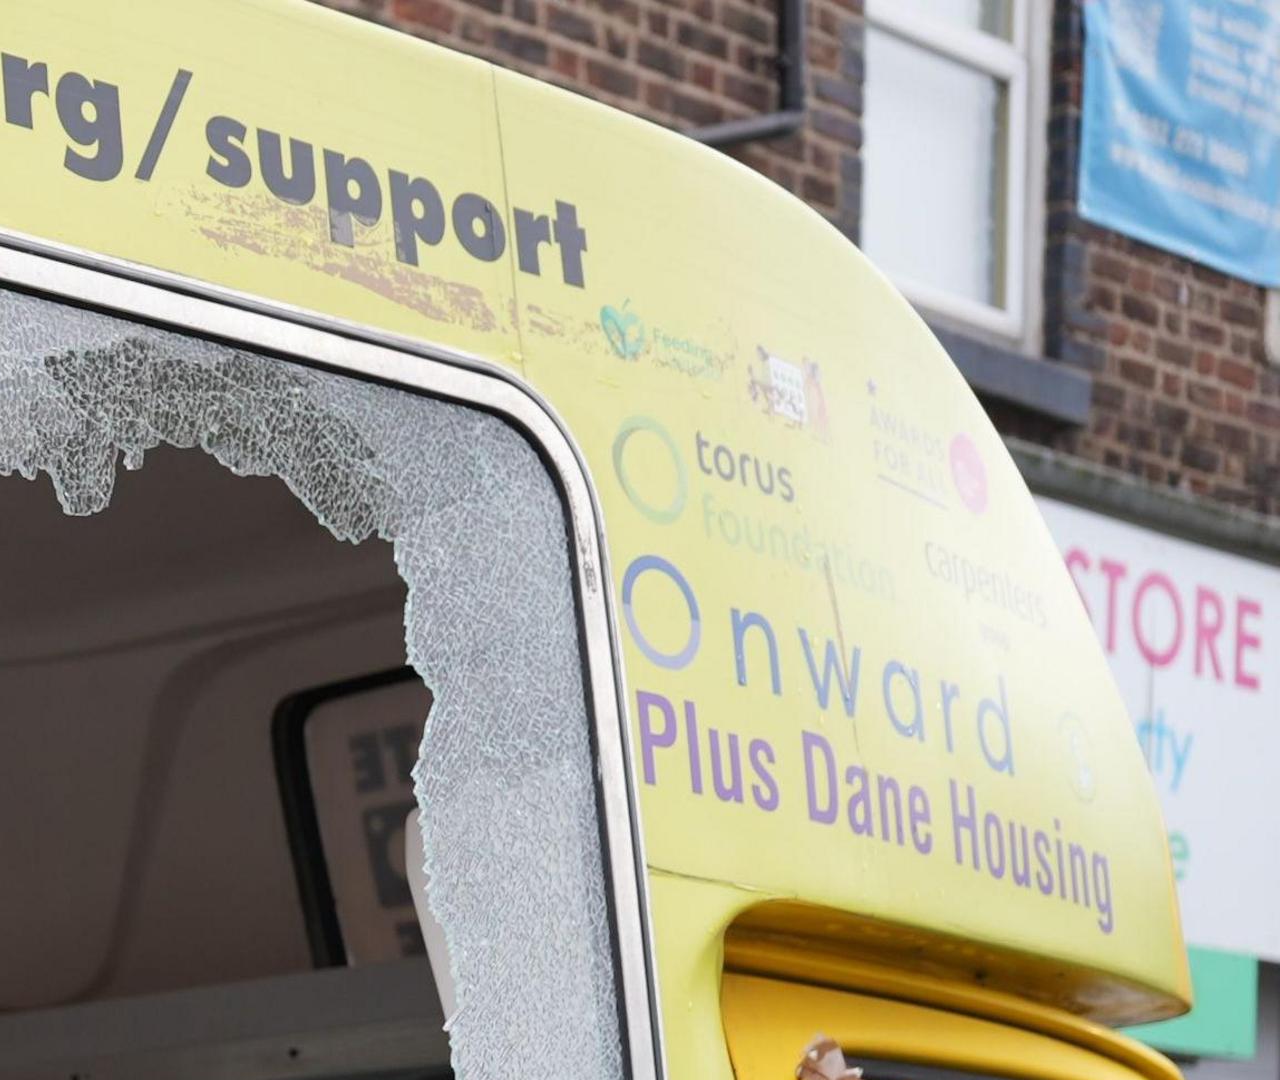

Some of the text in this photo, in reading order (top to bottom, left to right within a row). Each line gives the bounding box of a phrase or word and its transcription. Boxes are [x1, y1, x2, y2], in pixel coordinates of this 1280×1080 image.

[696, 430, 795, 503] torus
[702, 490, 897, 602] foundation
[622, 555, 1016, 777] Onward
[635, 689, 1114, 935] Plus Dane Housing
